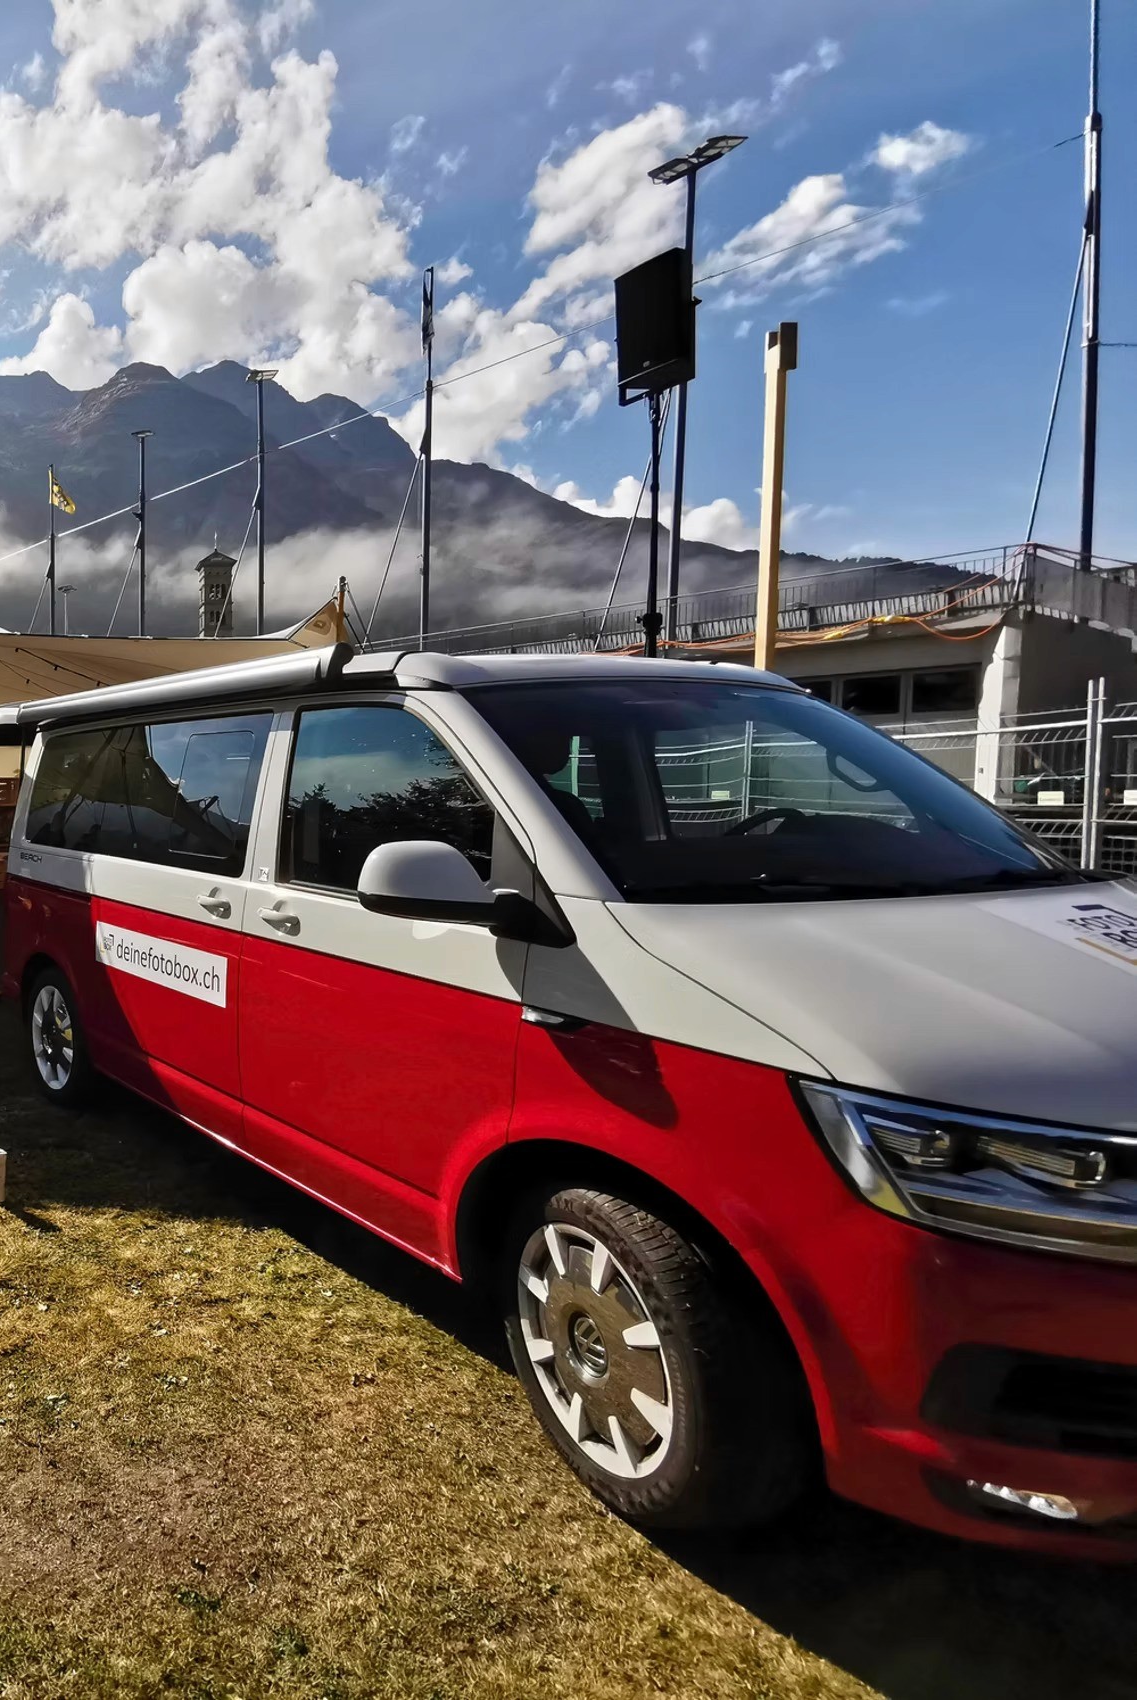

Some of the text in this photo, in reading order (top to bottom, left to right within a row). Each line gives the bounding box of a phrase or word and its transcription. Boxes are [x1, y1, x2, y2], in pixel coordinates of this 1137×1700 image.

[20, 852, 42, 863] BEACH
[1066, 914, 1135, 931] FOTO
[1101, 929, 1137, 949] BO
[116, 939, 220, 993] deinefotobox.ch
